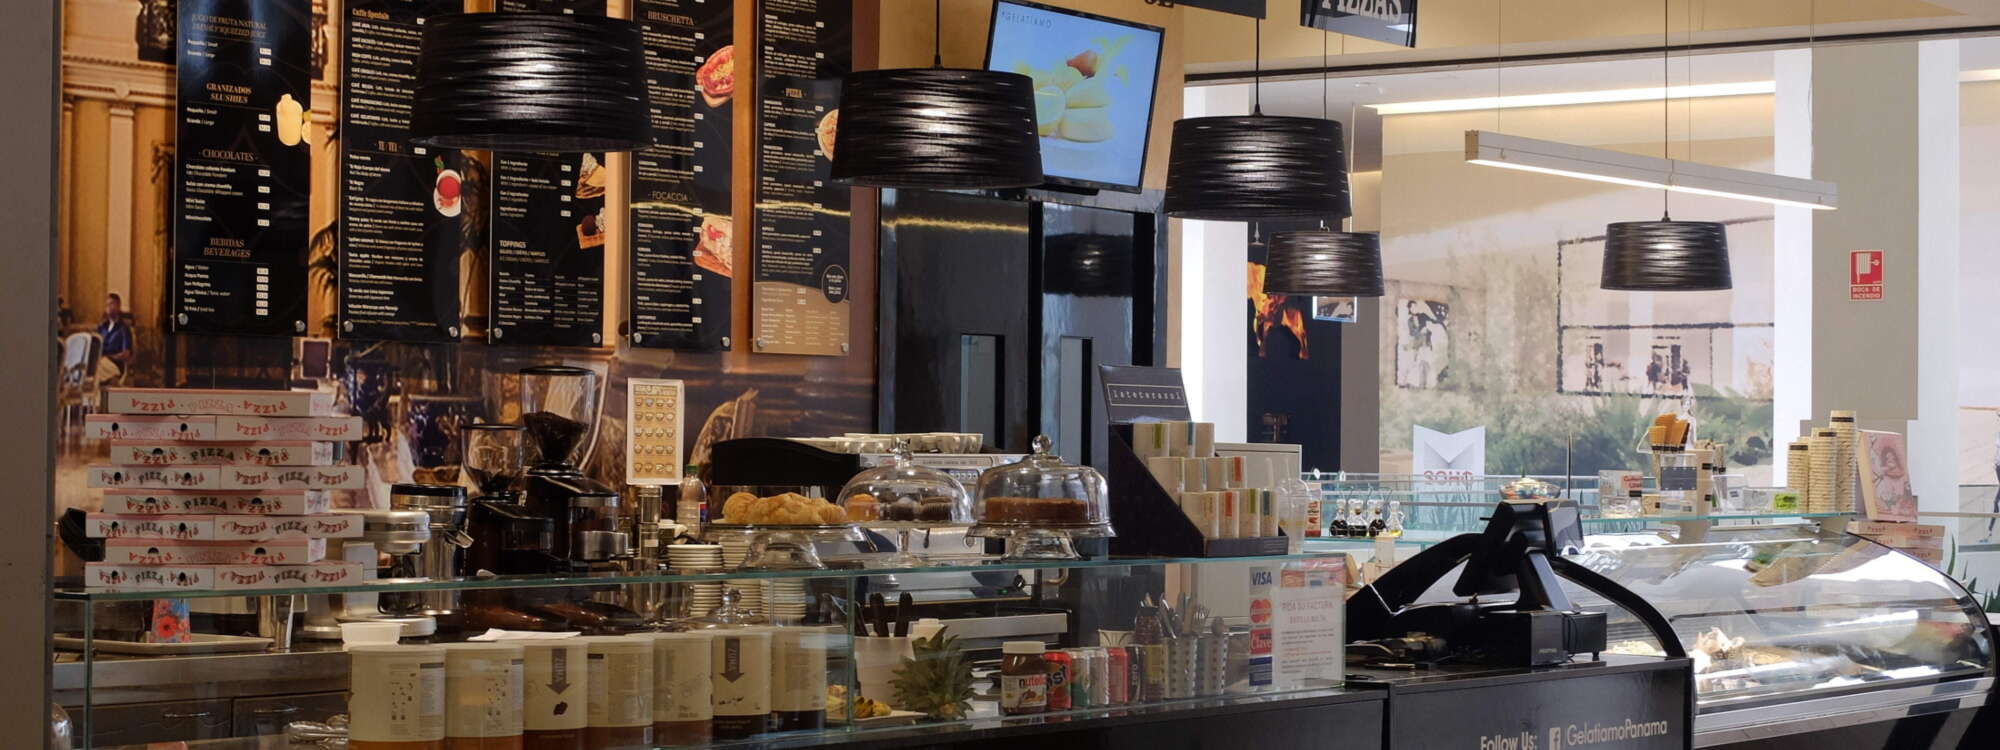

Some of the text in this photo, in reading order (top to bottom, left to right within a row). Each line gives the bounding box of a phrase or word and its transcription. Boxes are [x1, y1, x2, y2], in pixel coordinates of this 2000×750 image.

[648, 11, 695, 26] BRUSCHETTA
[206, 82, 252, 95] GRANIZADOS
[210, 92, 249, 104] SLUSHIES
[202, 149, 255, 161] CHOCOLATES
[652, 191, 688, 201] FOCACCIA
[209, 237, 246, 248] BEBIDAS
[499, 240, 527, 248] TOPPINGS
[203, 248, 252, 258] BEVERAGES
[1852, 286, 1882, 294] BOCA DE
[132, 399, 177, 412] PIZZA
[244, 400, 288, 414] PIZZA
[236, 422, 270, 436] PIZZA
[317, 423, 350, 437] PIZZA
[190, 447, 235, 462] PIZZA
[235, 471, 349, 486] PIZZA PIZZA PIZZA
[184, 496, 227, 511] PIZZA
[232, 520, 349, 536] PIZZA PIZZA PIZZA
[232, 568, 348, 585] PIZZA PIZZA PIZZA
[1252, 572, 1272, 585] VISA
[1480, 731, 1537, 750] Follow Us:
